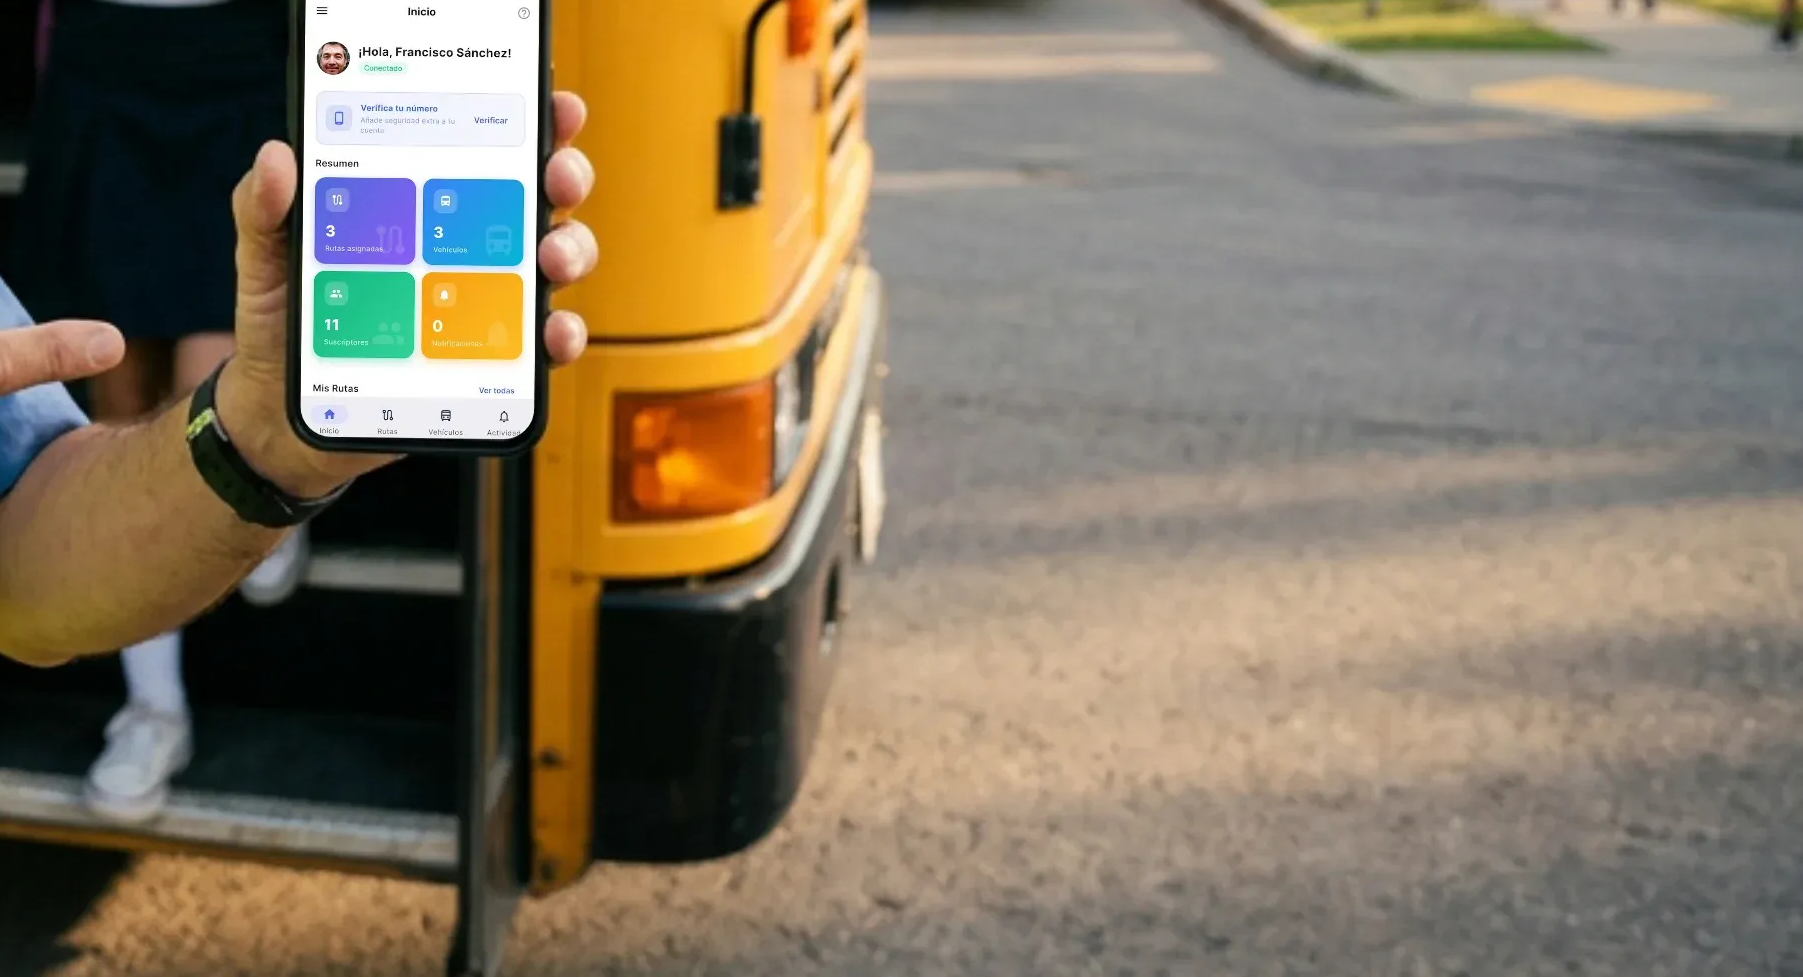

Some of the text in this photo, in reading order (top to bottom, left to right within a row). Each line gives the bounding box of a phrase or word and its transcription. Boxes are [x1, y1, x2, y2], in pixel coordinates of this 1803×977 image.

[407, 6, 436, 17] Inicio
[358, 47, 512, 59] ¡Hola, Francisco Sánchez!
[363, 64, 403, 72] Conectado
[360, 104, 438, 113] Verifica tu número
[474, 116, 508, 125] Verificar
[315, 159, 359, 168] Resumen
[325, 224, 336, 237] 3
[433, 226, 444, 239] 3
[325, 245, 384, 254] Rutas asignadas
[432, 246, 468, 254] Vehículos
[324, 318, 340, 331] 11
[432, 320, 443, 333] 0
[323, 338, 369, 347] Suscriptores
[312, 384, 359, 394] Mis Rutas
[478, 386, 515, 395] Ver todas
[428, 427, 464, 436] Vehículos
